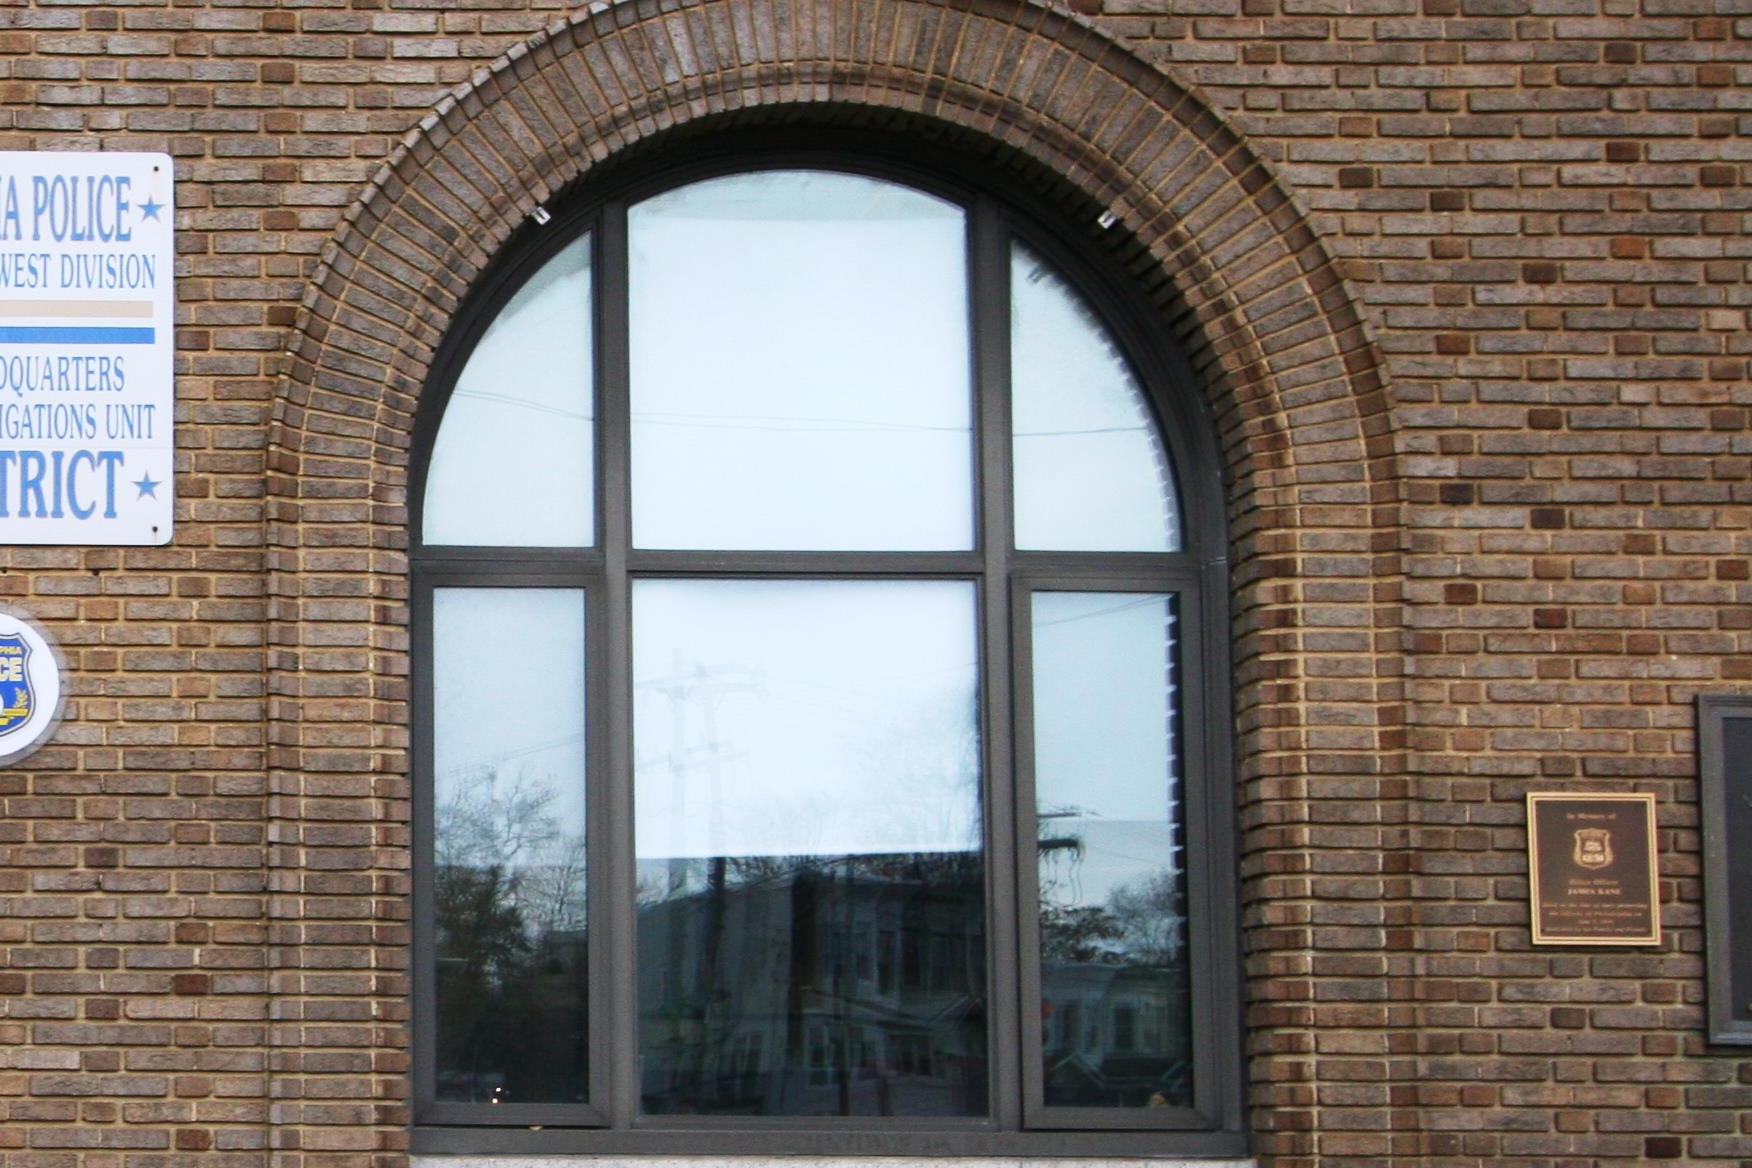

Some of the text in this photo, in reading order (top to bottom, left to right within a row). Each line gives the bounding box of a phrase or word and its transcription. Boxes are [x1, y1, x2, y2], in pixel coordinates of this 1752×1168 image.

[32, 175, 132, 242] POLICE
[60, 254, 156, 289] DIVISION
[105, 404, 156, 440] UNIT
